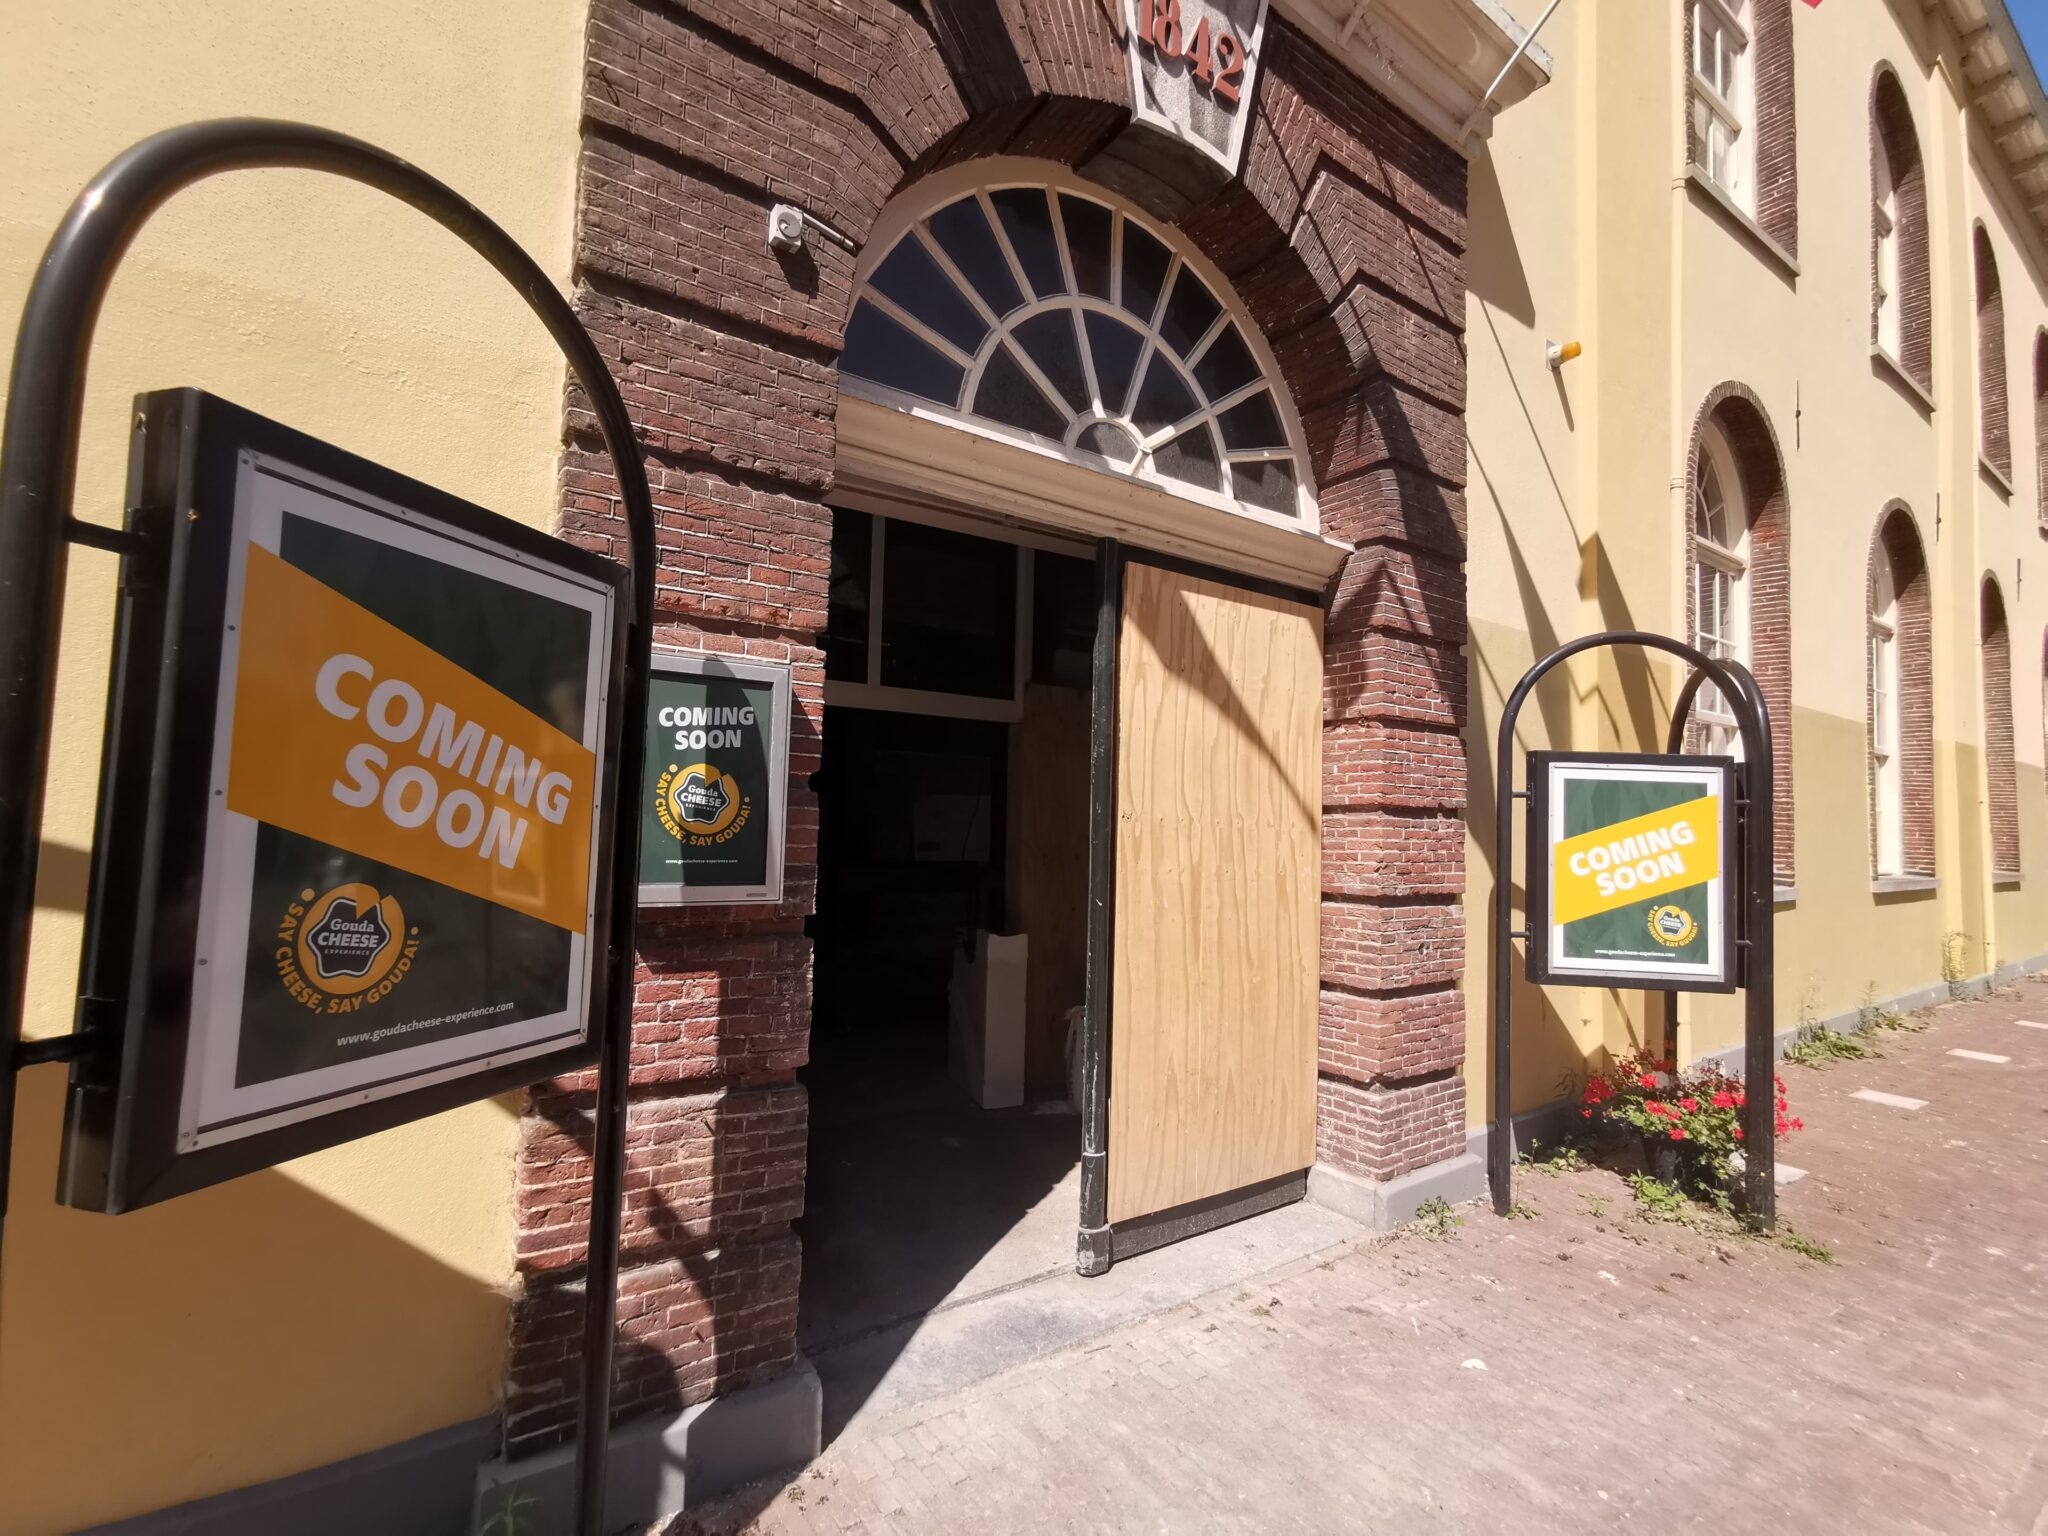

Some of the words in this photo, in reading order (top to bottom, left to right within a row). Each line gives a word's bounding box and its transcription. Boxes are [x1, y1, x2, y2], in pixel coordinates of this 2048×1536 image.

[1138, 0, 1245, 102] 1842
[658, 706, 755, 727] COMING
[315, 653, 573, 825] COMING
[674, 729, 742, 750] SOON
[656, 772, 672, 796] SAY
[680, 792, 722, 807] CHEESE
[688, 784, 718, 797] Gouda
[332, 743, 529, 869] SOON
[655, 798, 686, 844] CHEESE,
[716, 804, 751, 843] GOUDA!
[690, 835, 713, 846] SAY
[1569, 820, 1696, 876] COMING
[1595, 851, 1685, 897] SOON
[278, 902, 305, 942] SAY
[317, 932, 380, 948] CHEESE
[330, 918, 374, 932] Gouda
[324, 948, 370, 956] EXPERIENCE
[366, 939, 420, 1004] GOUDA!
[275, 946, 323, 1014] CHEESE,
[327, 995, 363, 1014] SAY
[336, 1001, 514, 1047] www.goudacheese-experience.com
